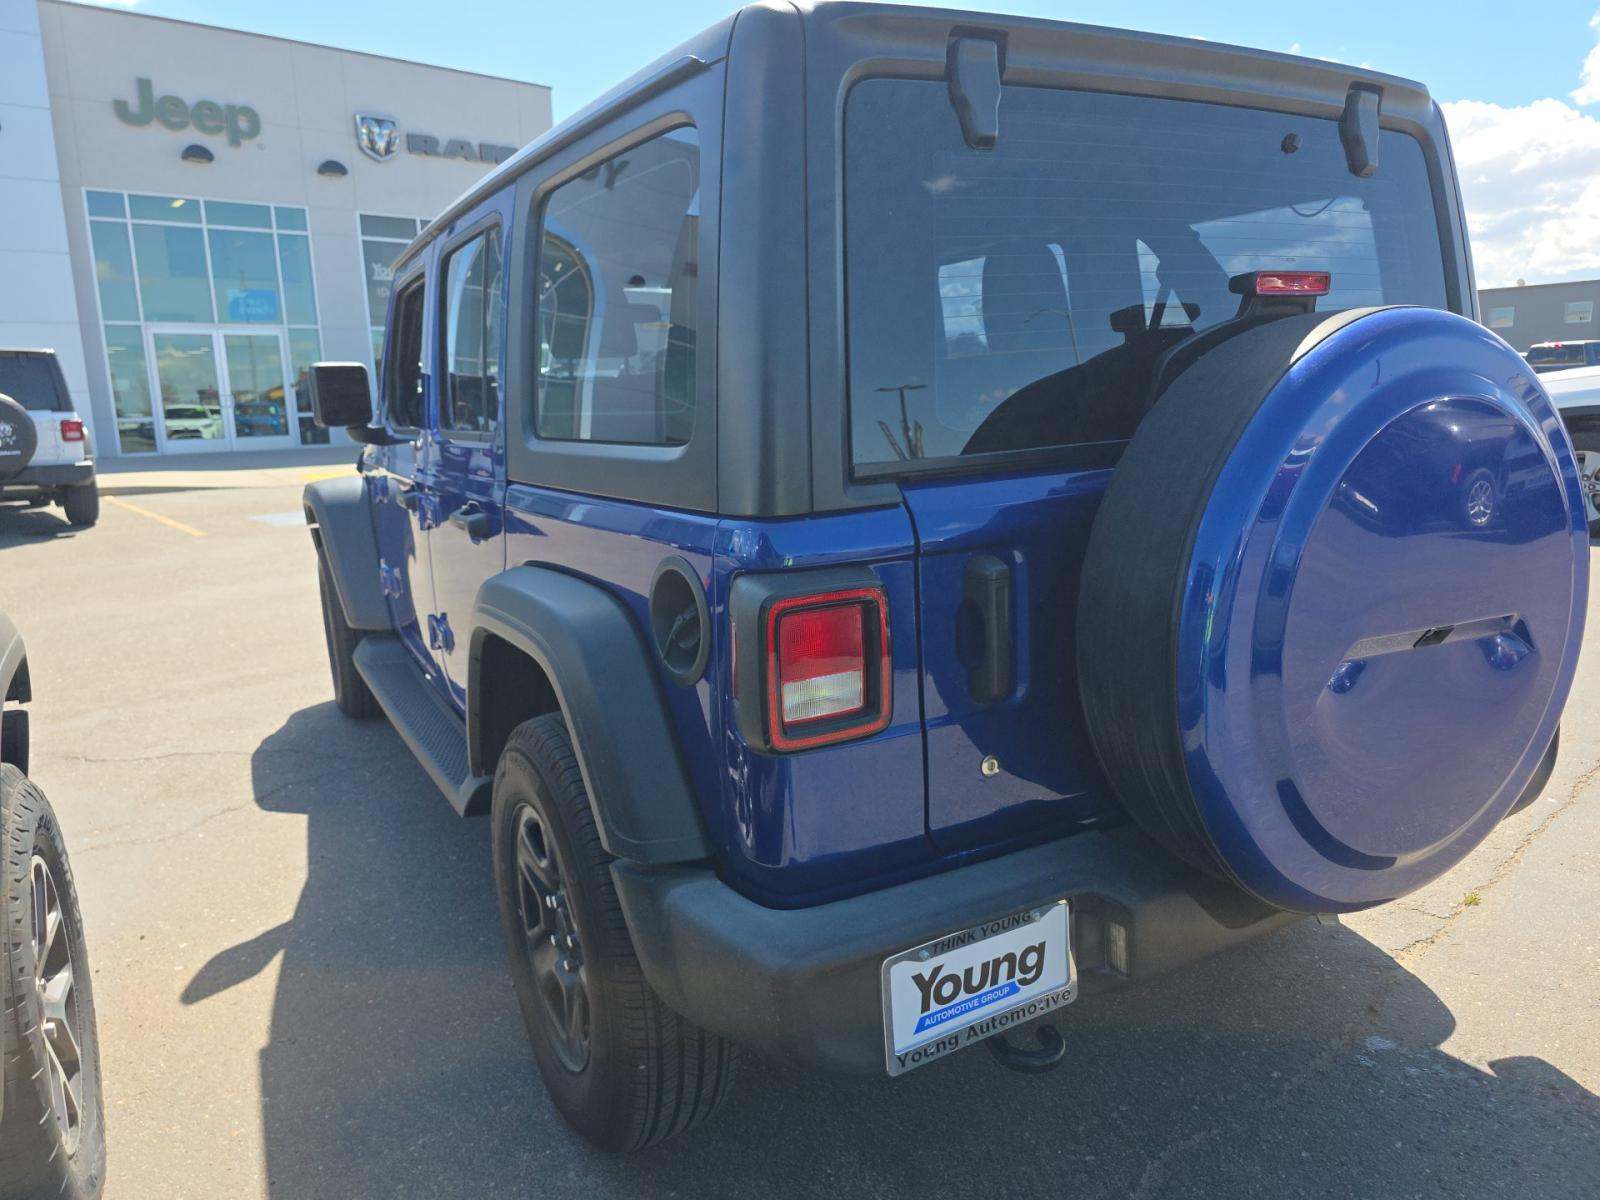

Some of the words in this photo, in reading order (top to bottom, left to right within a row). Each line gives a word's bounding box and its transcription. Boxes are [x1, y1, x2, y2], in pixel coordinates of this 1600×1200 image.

[113, 76, 261, 147] Jeep
[933, 930, 976, 956] THINK
[981, 911, 1032, 937] YOUNG
[911, 941, 1047, 1014] Young
[924, 998, 980, 1027] AUTOMOTIVE
[980, 986, 1010, 1003] GROUP
